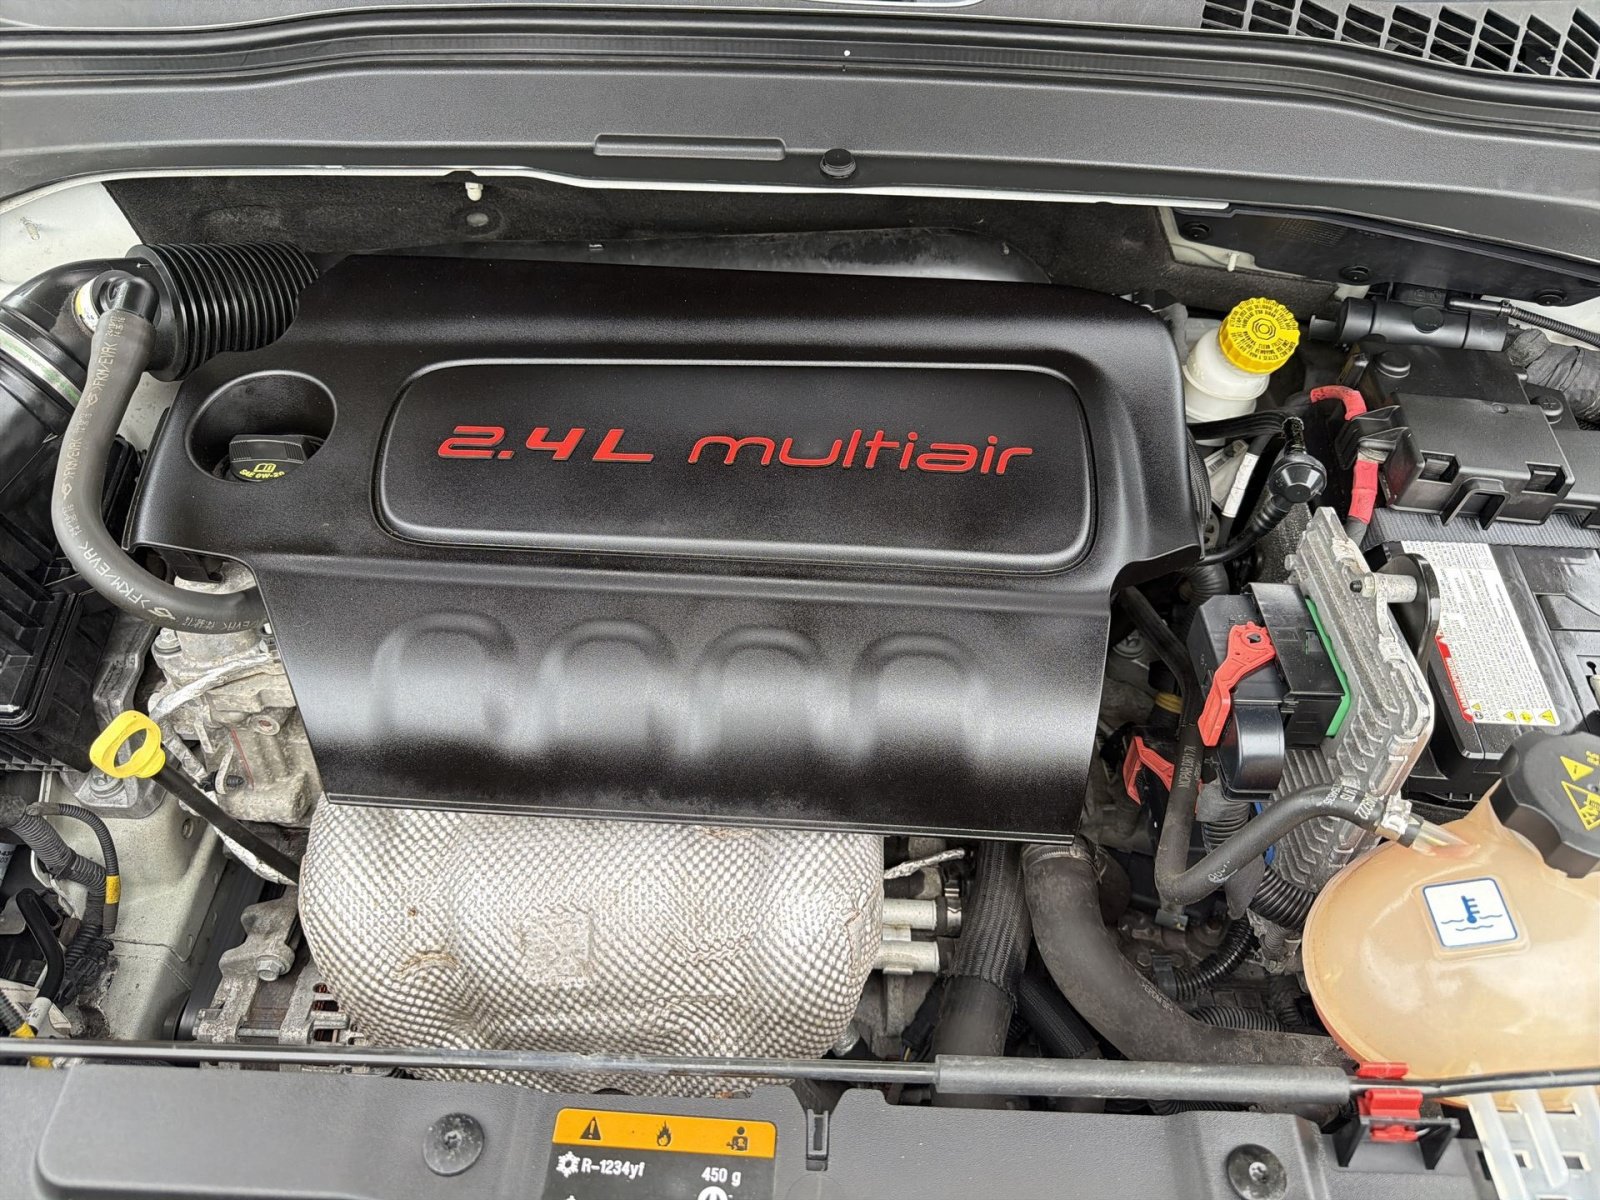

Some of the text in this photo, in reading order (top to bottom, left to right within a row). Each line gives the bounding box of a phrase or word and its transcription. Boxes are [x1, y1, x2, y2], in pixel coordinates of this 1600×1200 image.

[687, 429, 1033, 475] multiair
[581, 1157, 742, 1187] R-1234yf 450 g
